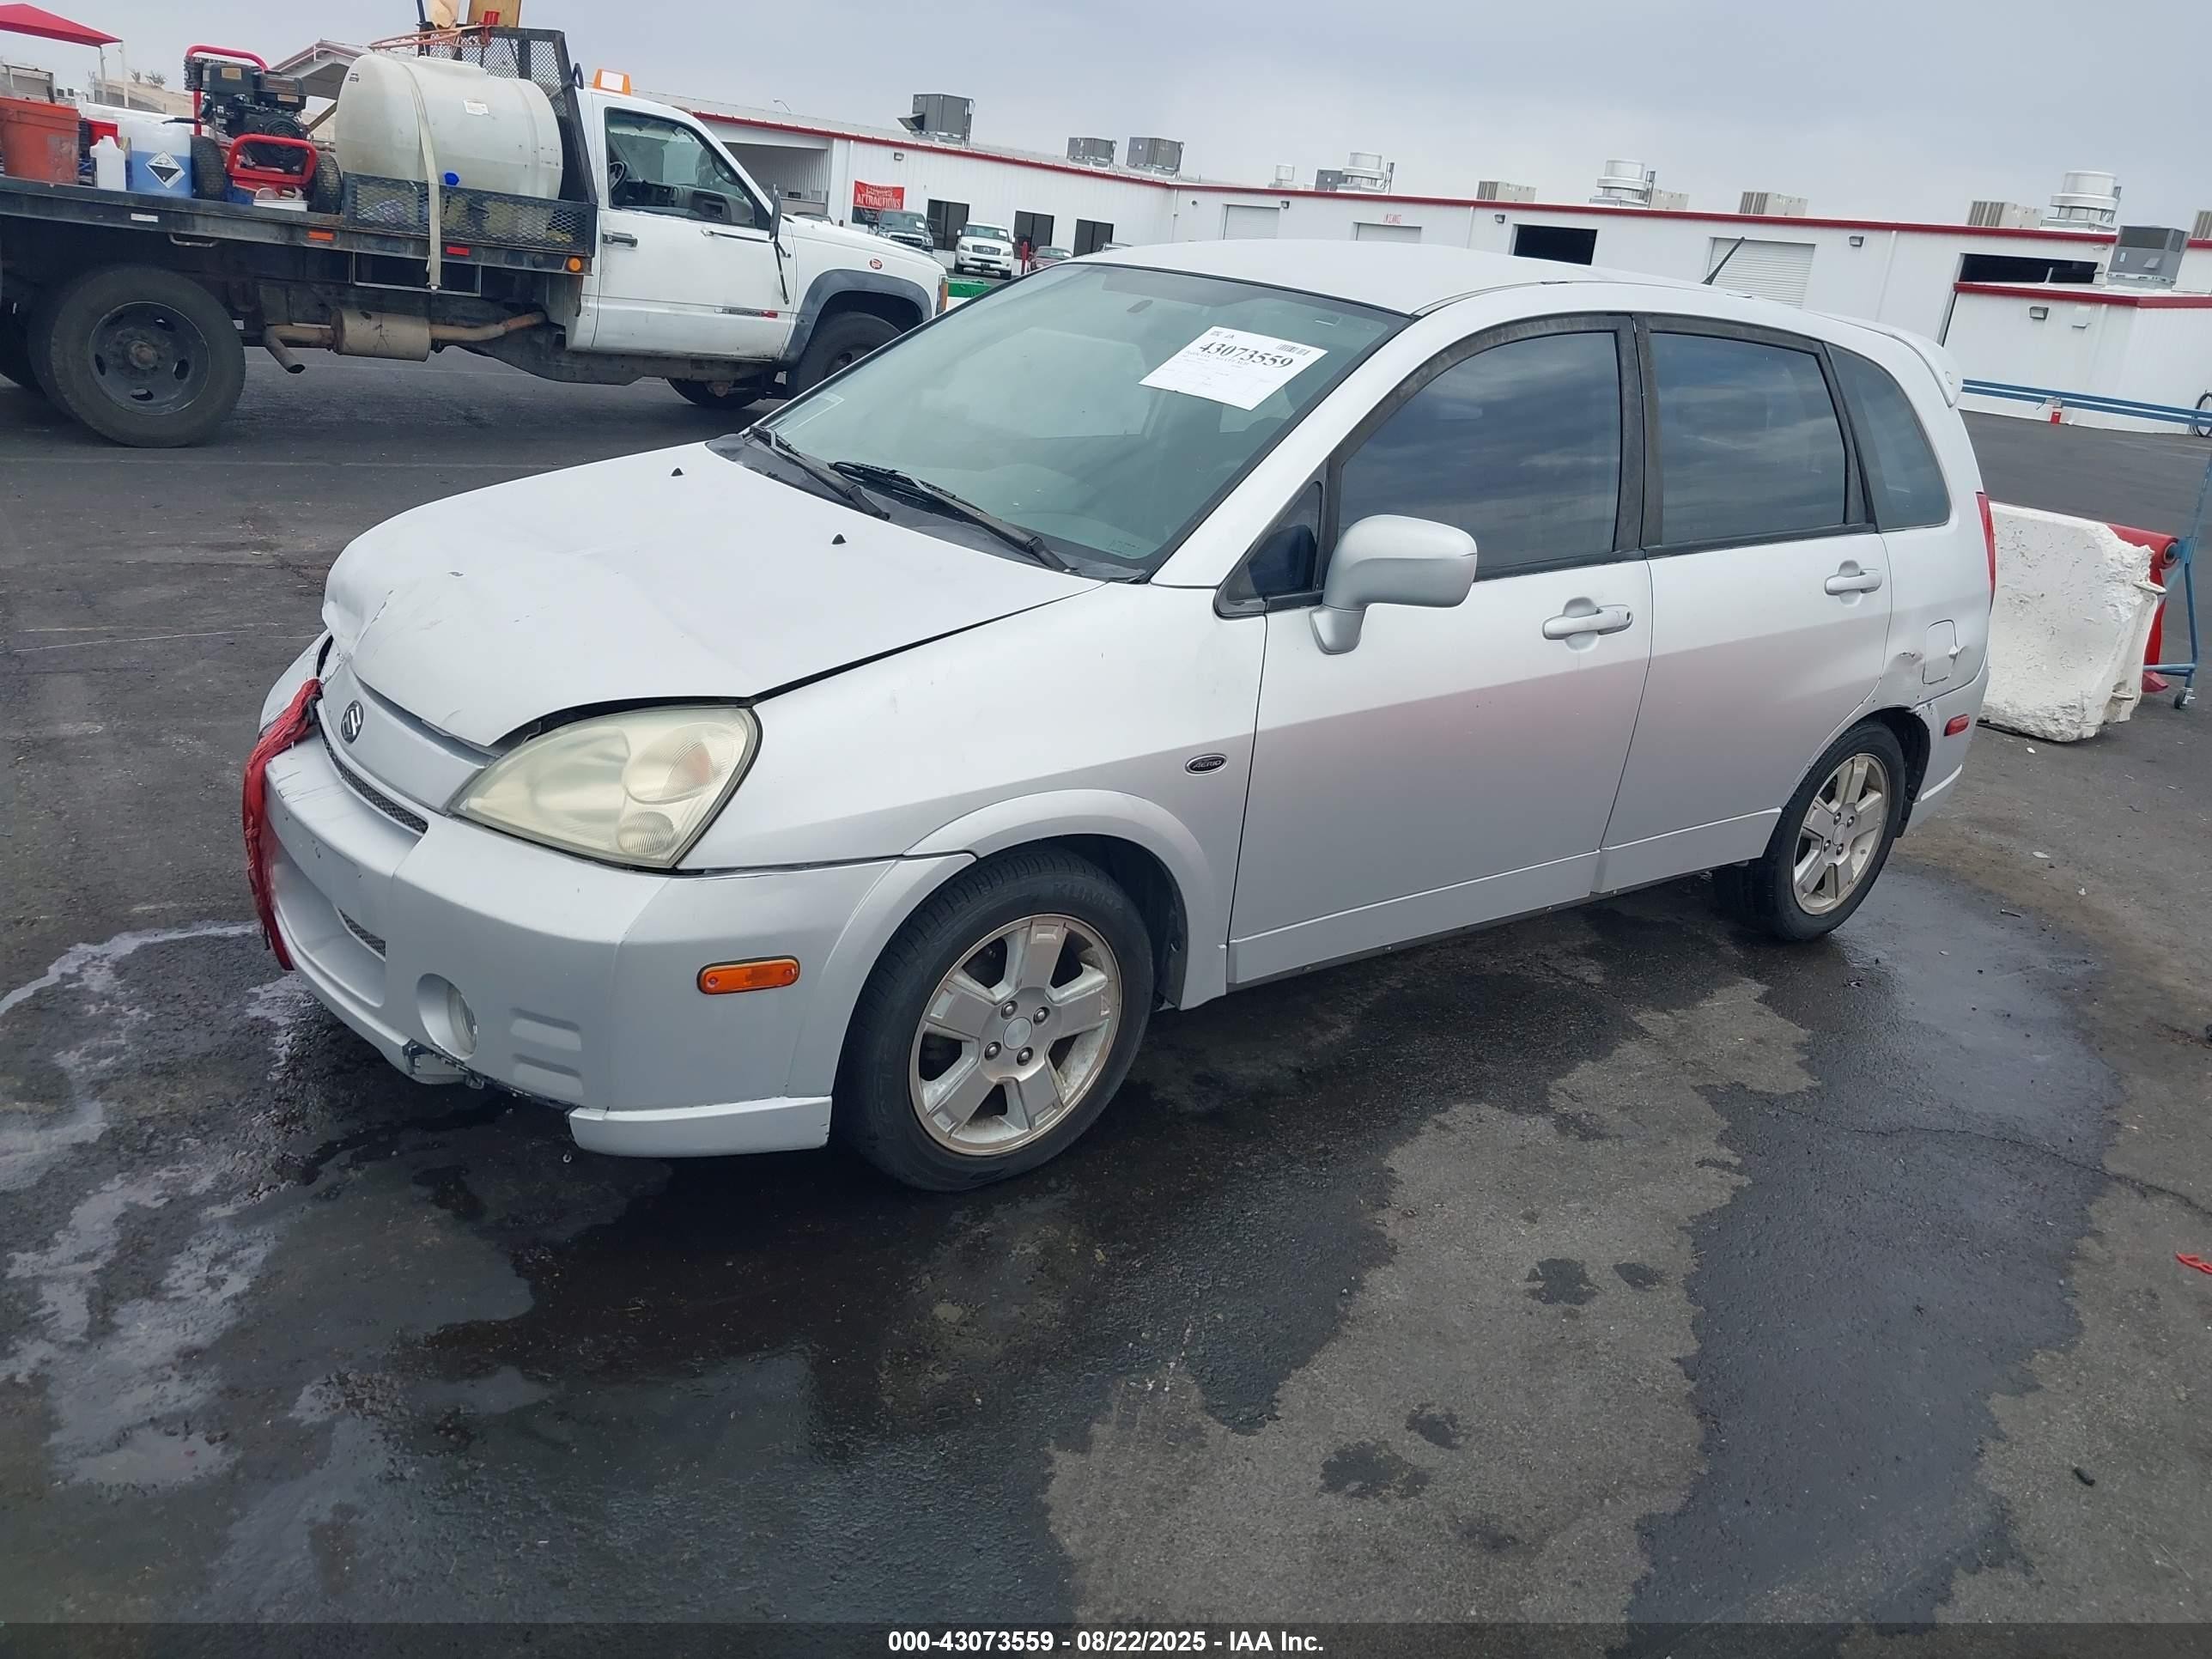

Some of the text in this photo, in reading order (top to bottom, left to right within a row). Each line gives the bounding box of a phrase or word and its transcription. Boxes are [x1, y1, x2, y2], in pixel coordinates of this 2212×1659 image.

[856, 193, 901, 209] ATTRACTIONS
[1199, 342, 1293, 368] 43073559
[1191, 759, 1222, 769] AERIO
